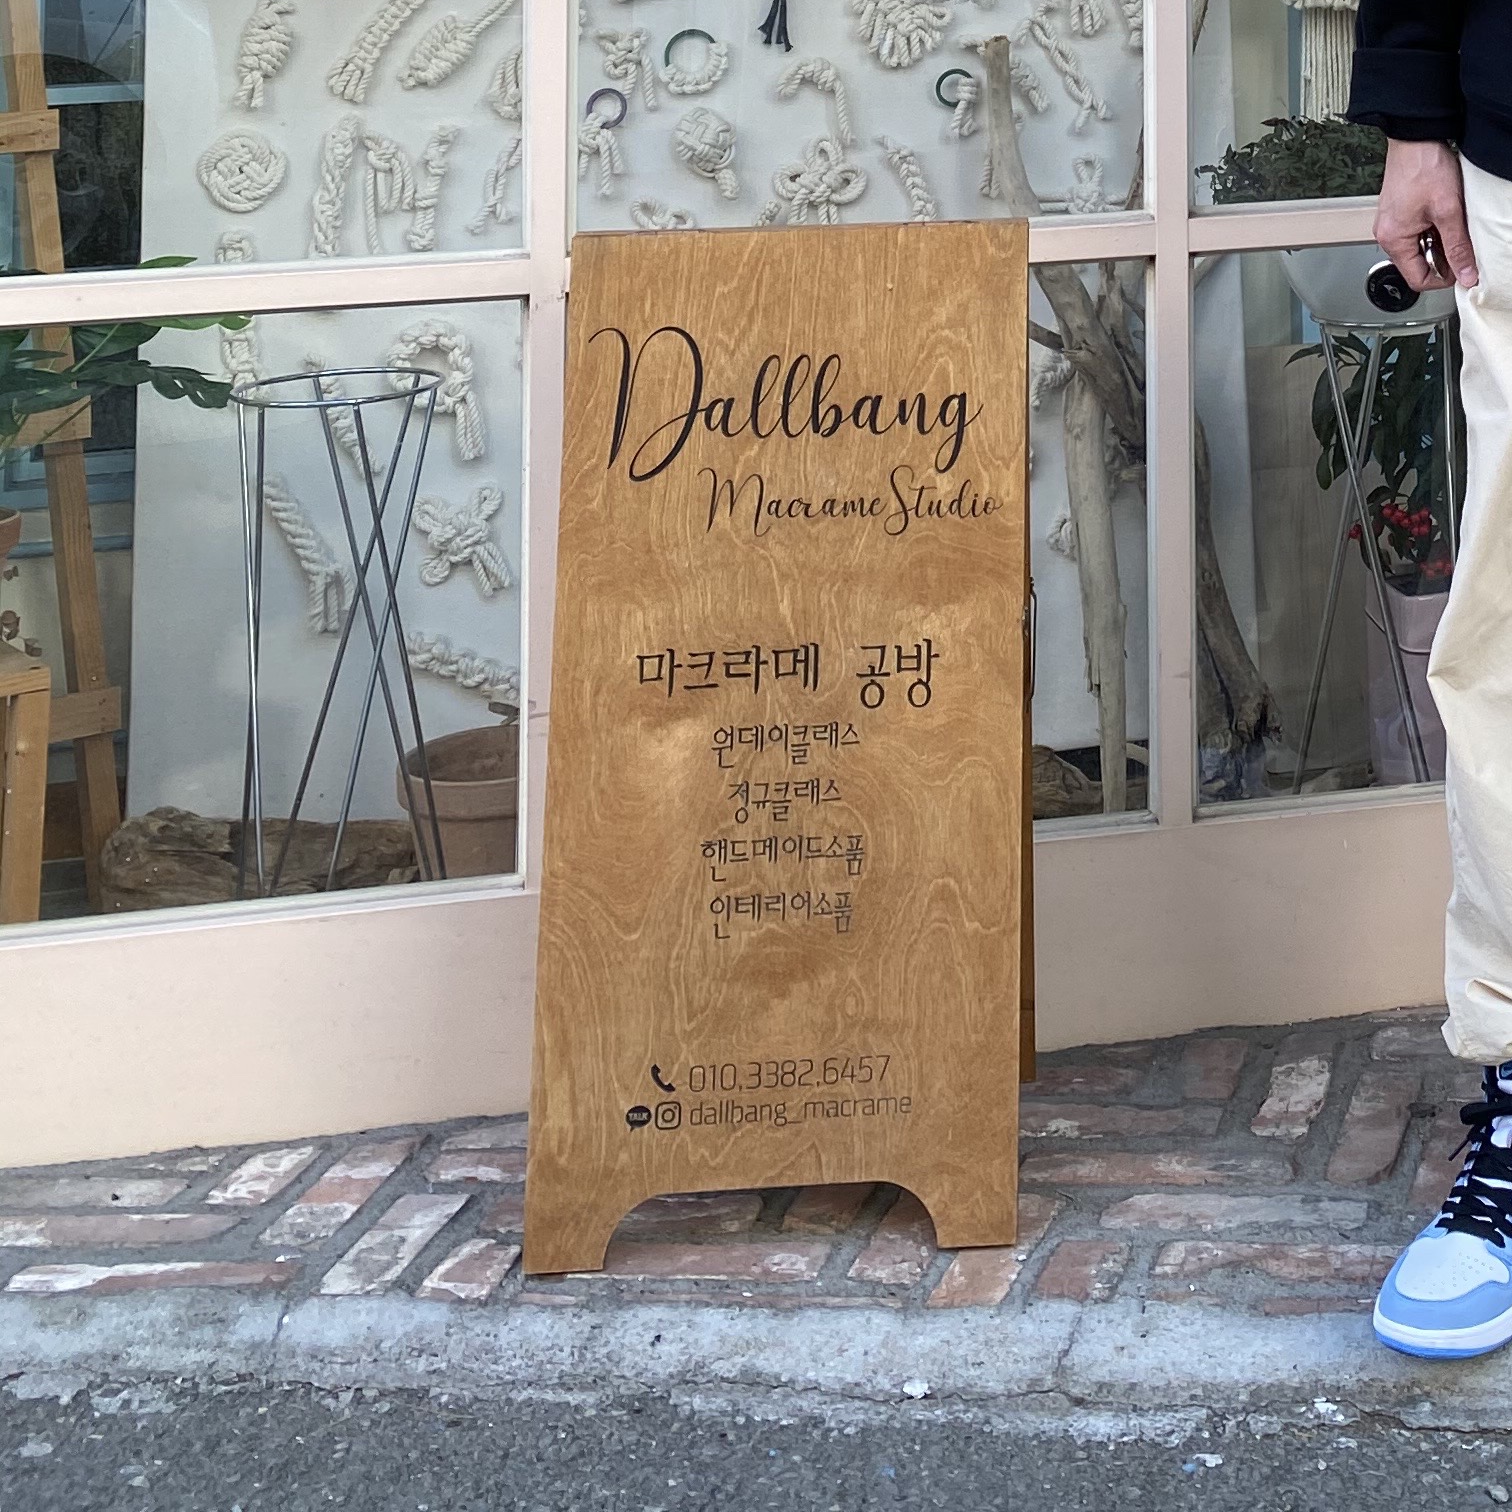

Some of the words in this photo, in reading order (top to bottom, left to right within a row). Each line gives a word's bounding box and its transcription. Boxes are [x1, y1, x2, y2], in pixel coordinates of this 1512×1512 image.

[588, 326, 983, 481] Dallbang
[636, 642, 820, 698] 마크라메
[856, 639, 940, 709] 공방
[711, 722, 861, 768] 원데이클래스
[728, 778, 842, 824] 정규클래스
[701, 834, 866, 882] 핸드메이드소품
[709, 891, 853, 939] 인테리어소품
[689, 1093, 912, 1127] dallbang_macrame
